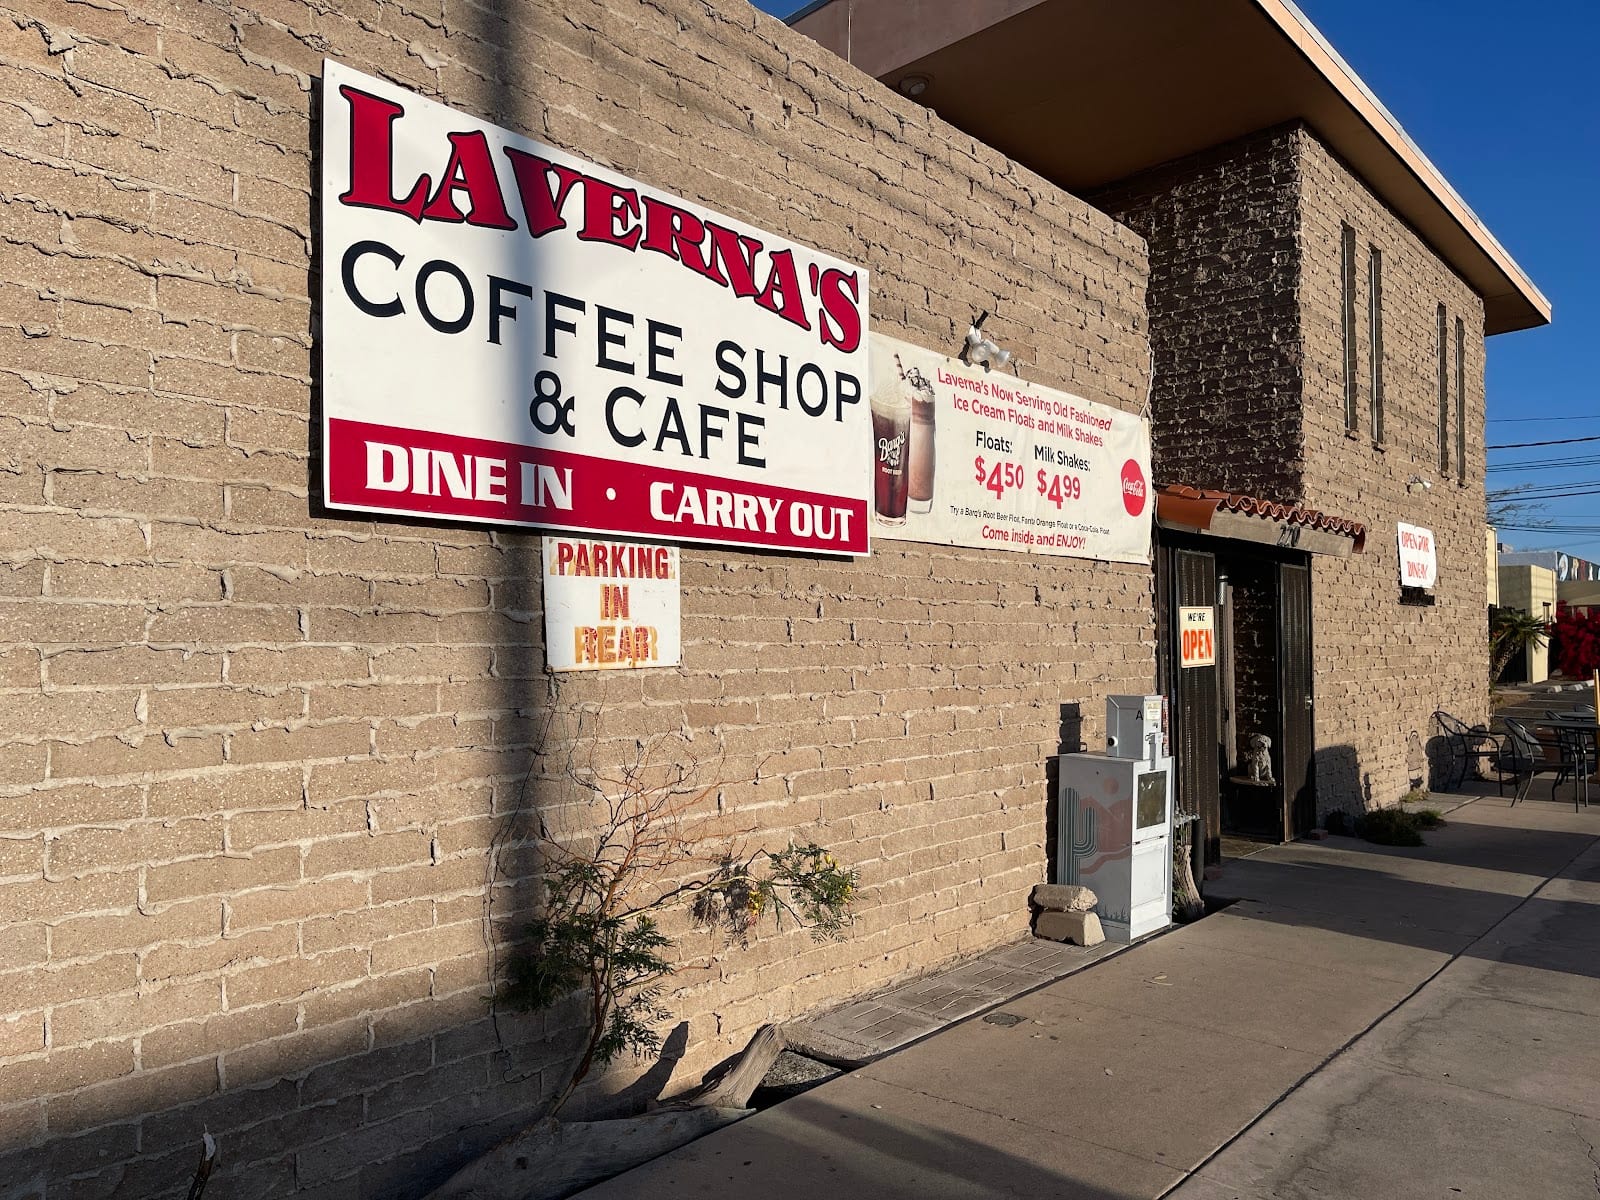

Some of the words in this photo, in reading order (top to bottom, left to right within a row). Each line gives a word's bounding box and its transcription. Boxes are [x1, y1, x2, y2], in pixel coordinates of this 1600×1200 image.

[339, 84, 862, 353] LAVERNA'S
[341, 240, 684, 387] COFFEE
[715, 340, 861, 422] SHOP
[937, 368, 989, 395] Laverna's
[992, 384, 1013, 402] Now
[1016, 392, 1051, 415] Serving
[1054, 402, 1068, 418] Old
[1070, 409, 1112, 431] Fashioned
[530, 370, 576, 437] &
[605, 386, 767, 469] CAFE
[954, 394, 968, 411] Ice
[972, 400, 1005, 421] Cream
[1008, 409, 1035, 429] Floats
[1038, 418, 1054, 434] and
[1057, 422, 1073, 439] Milk
[1075, 427, 1103, 447] Shakes
[976, 431, 1012, 453] Floats:
[1034, 445, 1054, 462] Milk
[1058, 451, 1091, 472] Shakes:
[364, 441, 506, 504] DINE
[519, 462, 573, 511] IN
[650, 480, 784, 529] CARRY
[790, 501, 854, 542] OUT
[950, 506, 959, 516] Try
[965, 508, 981, 518] Barq's
[983, 510, 995, 520] Root
[996, 512, 1008, 521] Beer
[1022, 516, 1036, 525] Fanta
[1036, 518, 1055, 528] Orange
[1057, 520, 1068, 529] Float
[982, 525, 1009, 541] Come
[1011, 529, 1034, 545] inside
[1037, 534, 1054, 546] and
[1056, 534, 1086, 549] ENJOY!
[558, 543, 668, 579] PARKING
[600, 584, 629, 620] IN
[1188, 612, 1206, 622] WE'RE
[574, 626, 659, 664] REAR
[1182, 628, 1212, 660] OPEN
